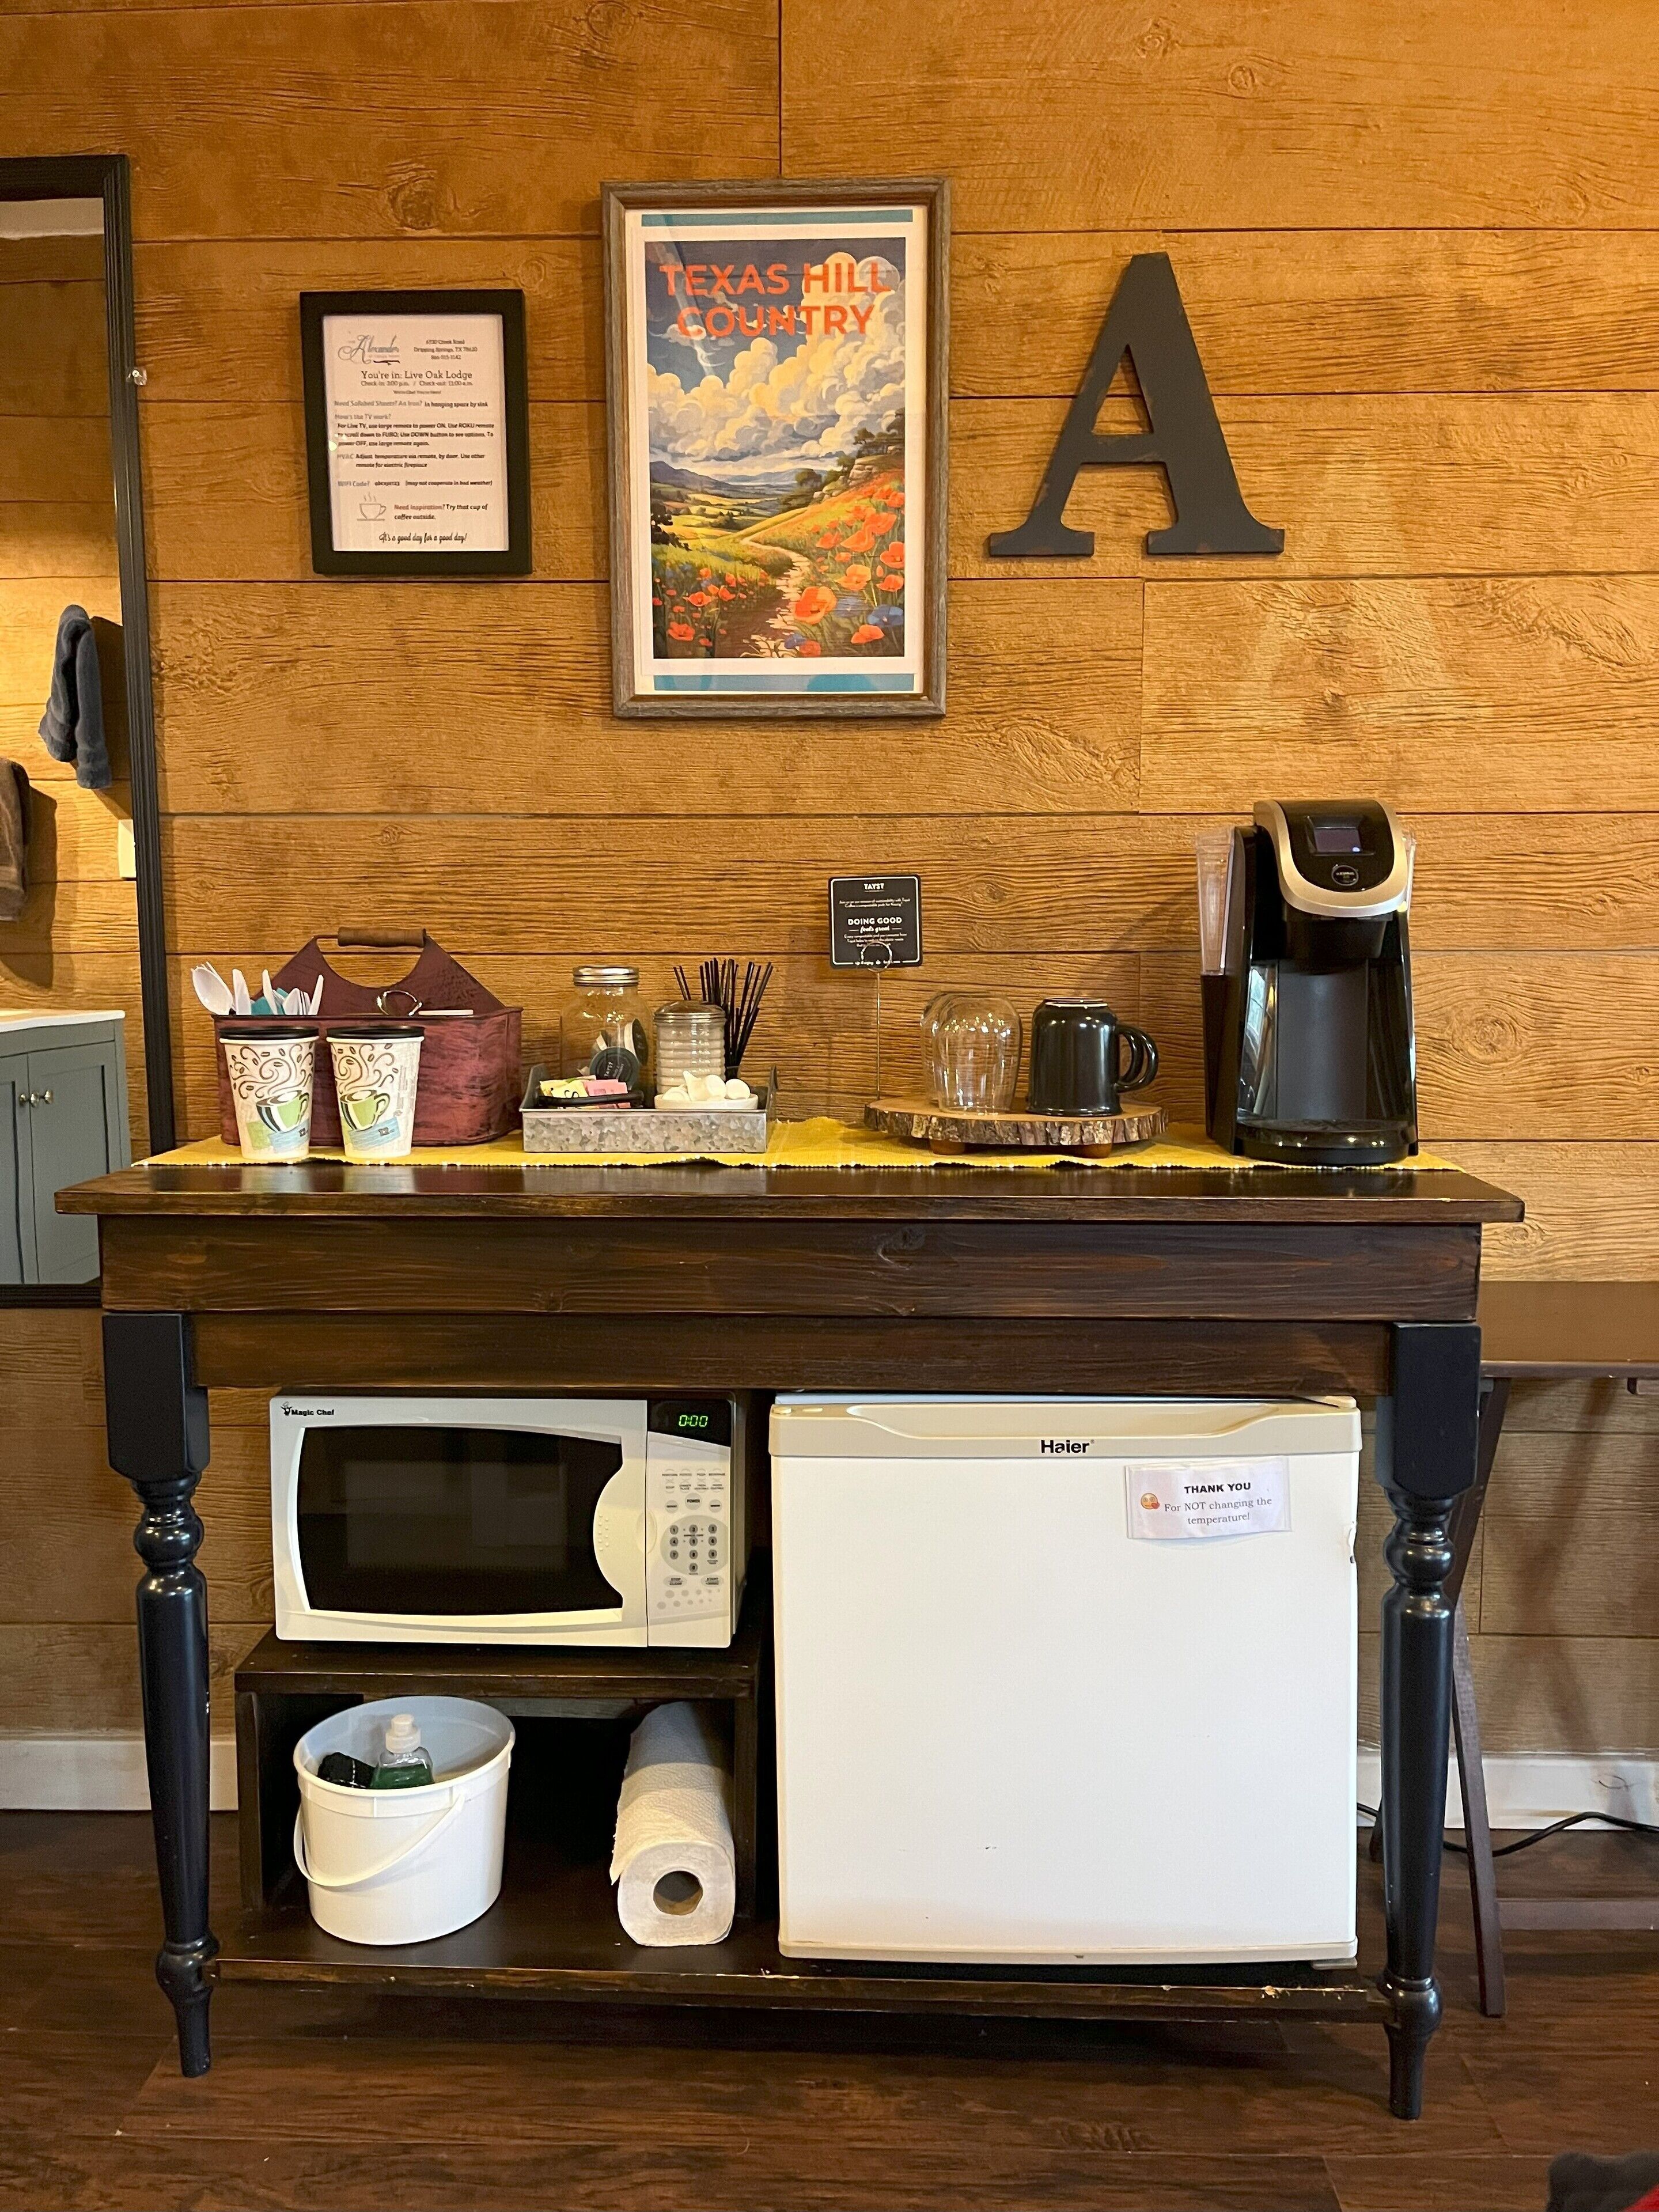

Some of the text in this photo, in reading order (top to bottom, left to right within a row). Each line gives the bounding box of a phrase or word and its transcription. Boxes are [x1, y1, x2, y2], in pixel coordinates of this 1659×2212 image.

[660, 263, 892, 296] TEXAS HILL
[677, 304, 875, 338] COUNTRY
[361, 369, 473, 381] You're in: Live Oak Lodge
[990, 252, 1285, 558] A
[397, 533, 411, 544] good
[412, 533, 423, 544] day
[439, 533, 453, 544] good
[454, 532, 468, 544] day!
[679, 1415, 709, 1427] 0:00
[1041, 1440, 1090, 1453] Haier
[1184, 1482, 1251, 1494] THANK YOU
[1164, 1498, 1272, 1512] For NOT changing the
[1187, 1512, 1251, 1525] temperature!
